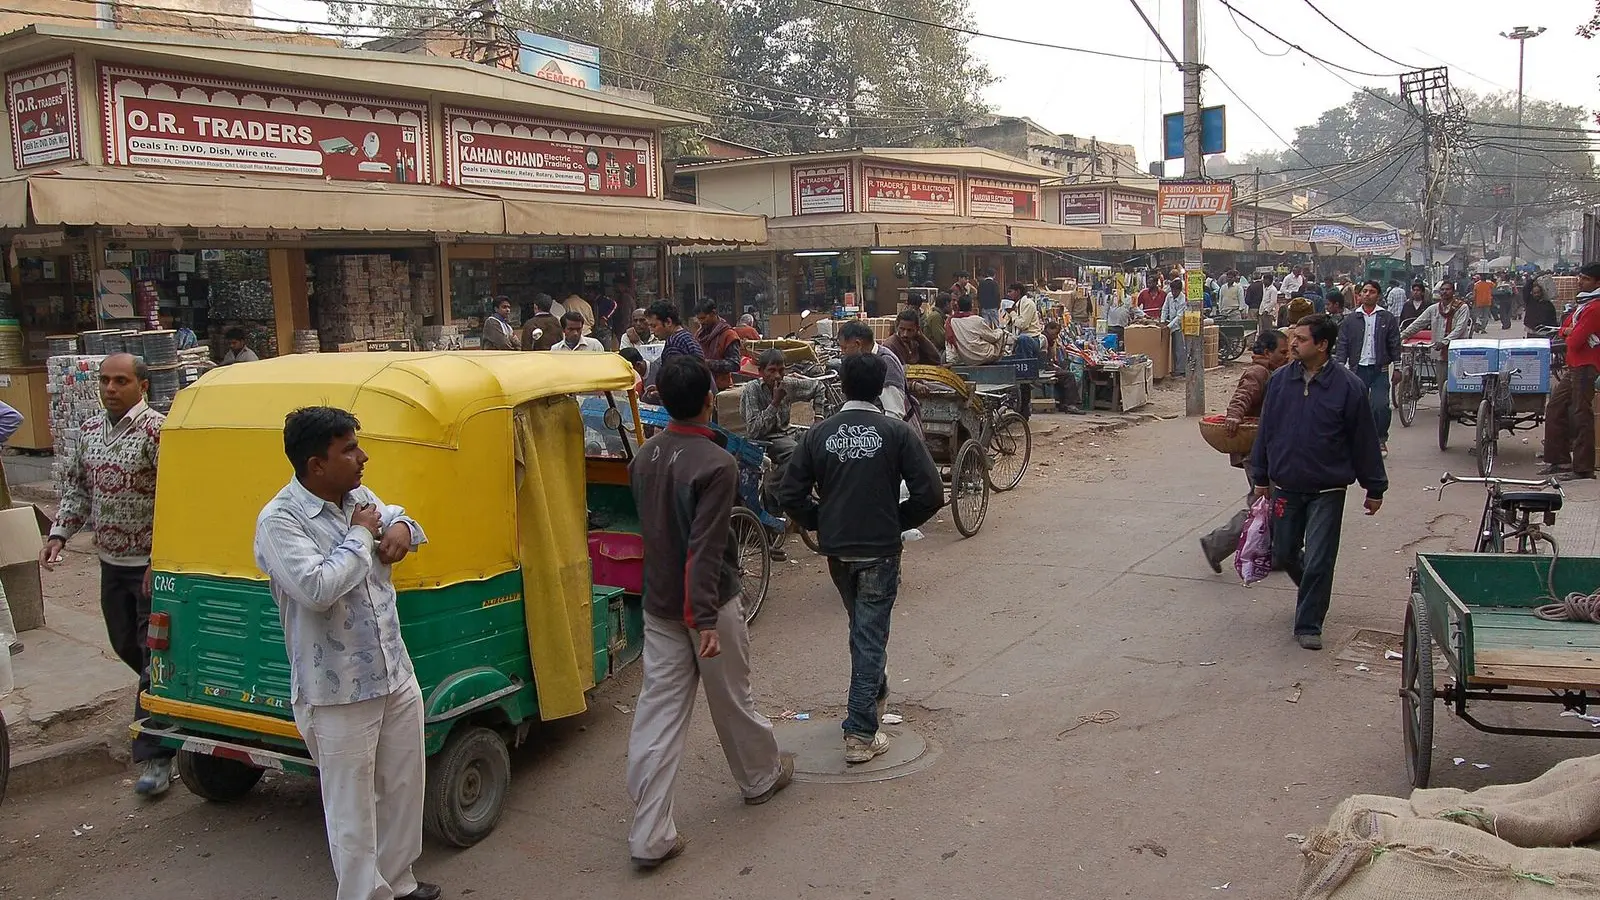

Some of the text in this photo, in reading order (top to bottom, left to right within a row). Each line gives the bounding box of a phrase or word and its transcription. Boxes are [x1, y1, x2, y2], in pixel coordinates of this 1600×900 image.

[17, 94, 63, 113] O.R. TRADERS
[128, 109, 313, 145] O.R. TRADERS
[404, 133, 414, 141] 17
[132, 140, 277, 159] Deals In: DVD, Dish, Wire etc.
[460, 146, 544, 168] KAHAN CHAND
[543, 153, 571, 162] Electric
[544, 160, 585, 170] Trading Co.
[875, 181, 904, 190] TRADERS
[1160, 185, 1169, 194] TV
[1169, 185, 1194, 193] COLOUR
[154, 575, 176, 592] CNG
